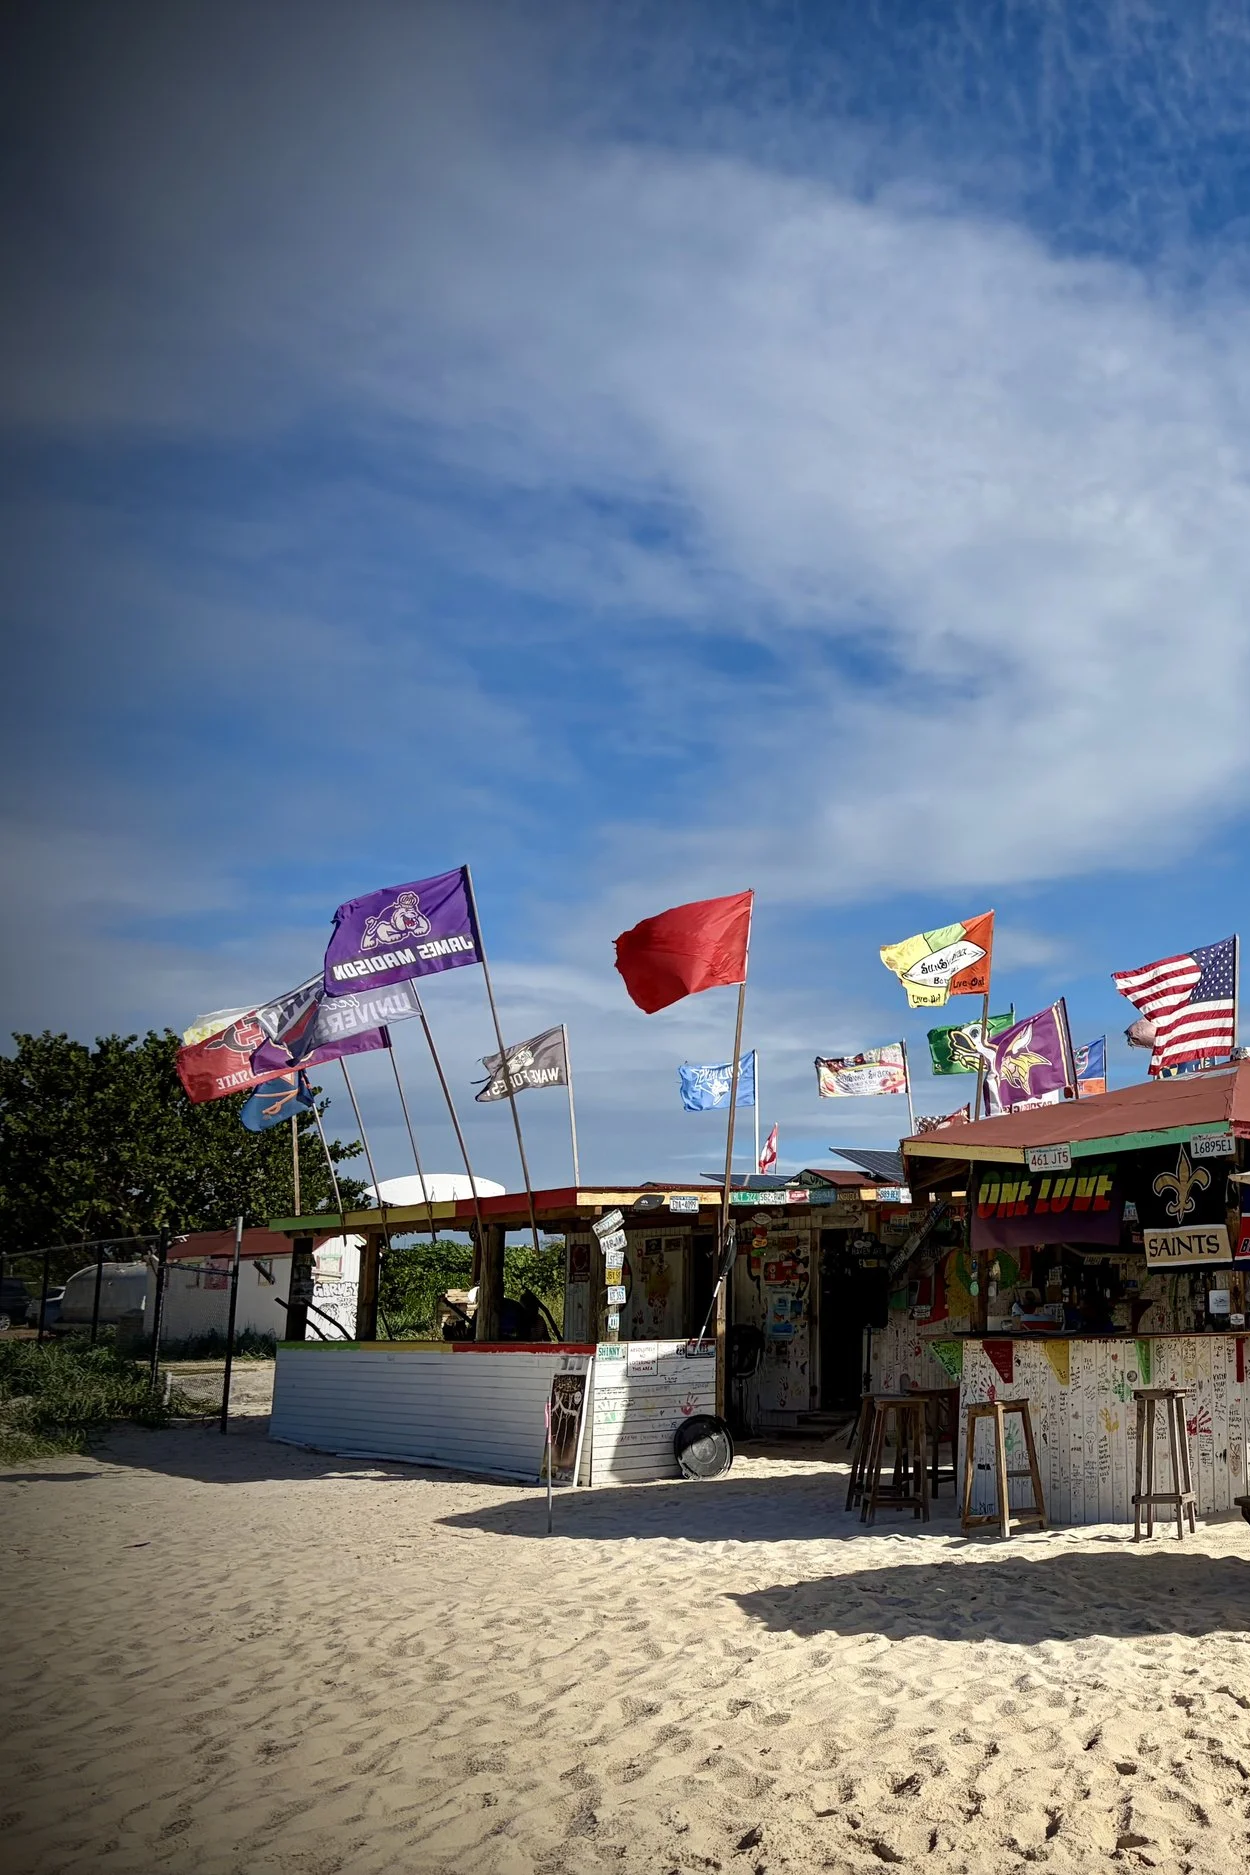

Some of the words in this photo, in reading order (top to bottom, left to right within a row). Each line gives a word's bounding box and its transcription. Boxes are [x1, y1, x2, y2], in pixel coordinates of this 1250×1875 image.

[1194, 1139, 1232, 1155] 16895E1
[1031, 1154, 1048, 1166] 461
[1052, 1151, 1069, 1165] JT5
[977, 1170, 1034, 1219] ONE
[1034, 1164, 1116, 1214] LOVE
[1148, 1234, 1220, 1257] SAINTS
